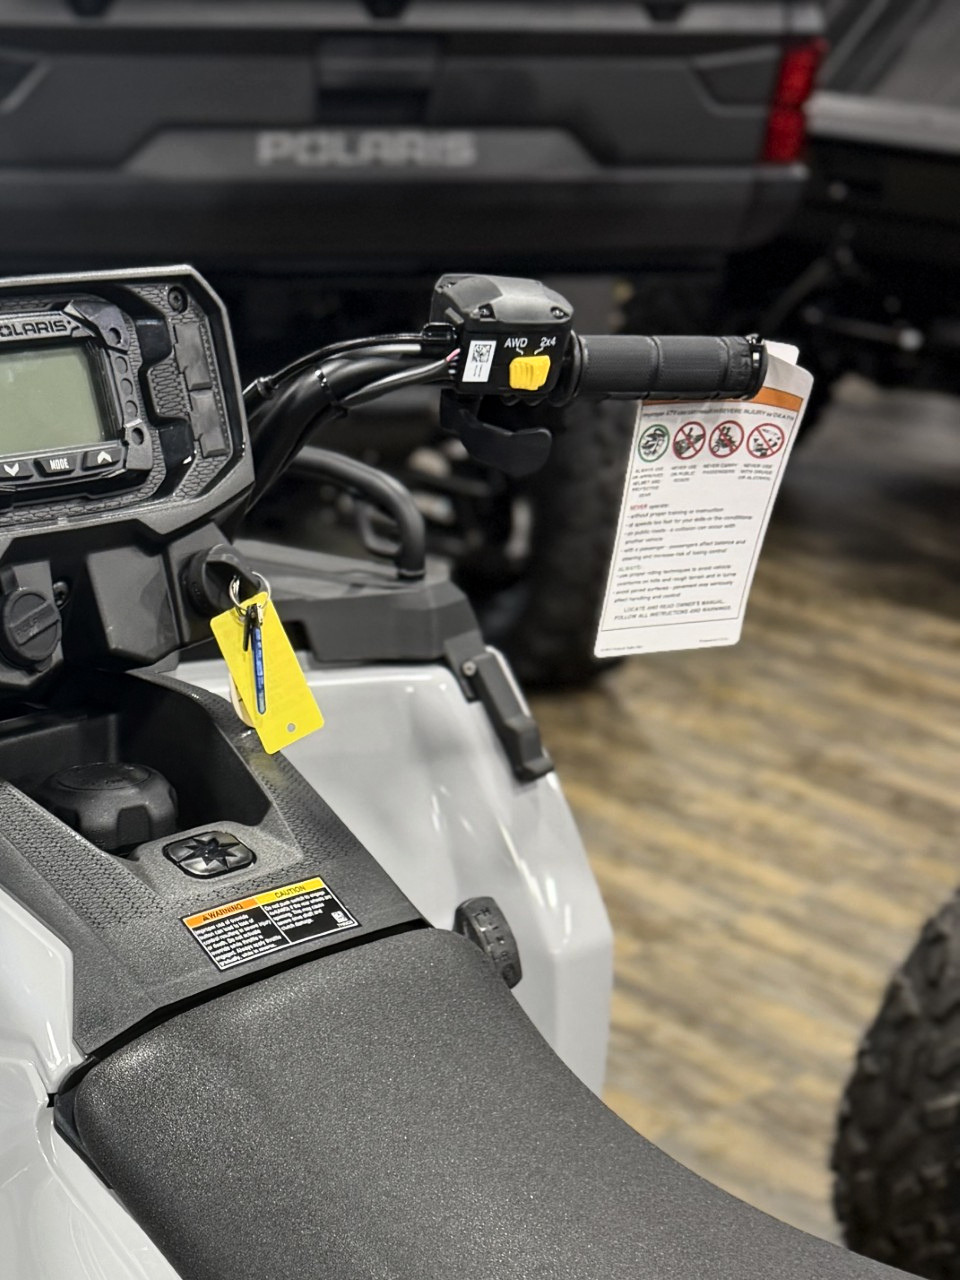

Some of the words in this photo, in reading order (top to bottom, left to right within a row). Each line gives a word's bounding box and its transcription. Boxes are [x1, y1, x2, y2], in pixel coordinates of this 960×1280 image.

[256, 130, 477, 167] POLARIS
[504, 338, 528, 348] AWD
[540, 336, 556, 347] 2x4
[50, 458, 69, 471] MODE
[273, 884, 306, 898] CAUTION
[207, 903, 244, 918] WARNING
